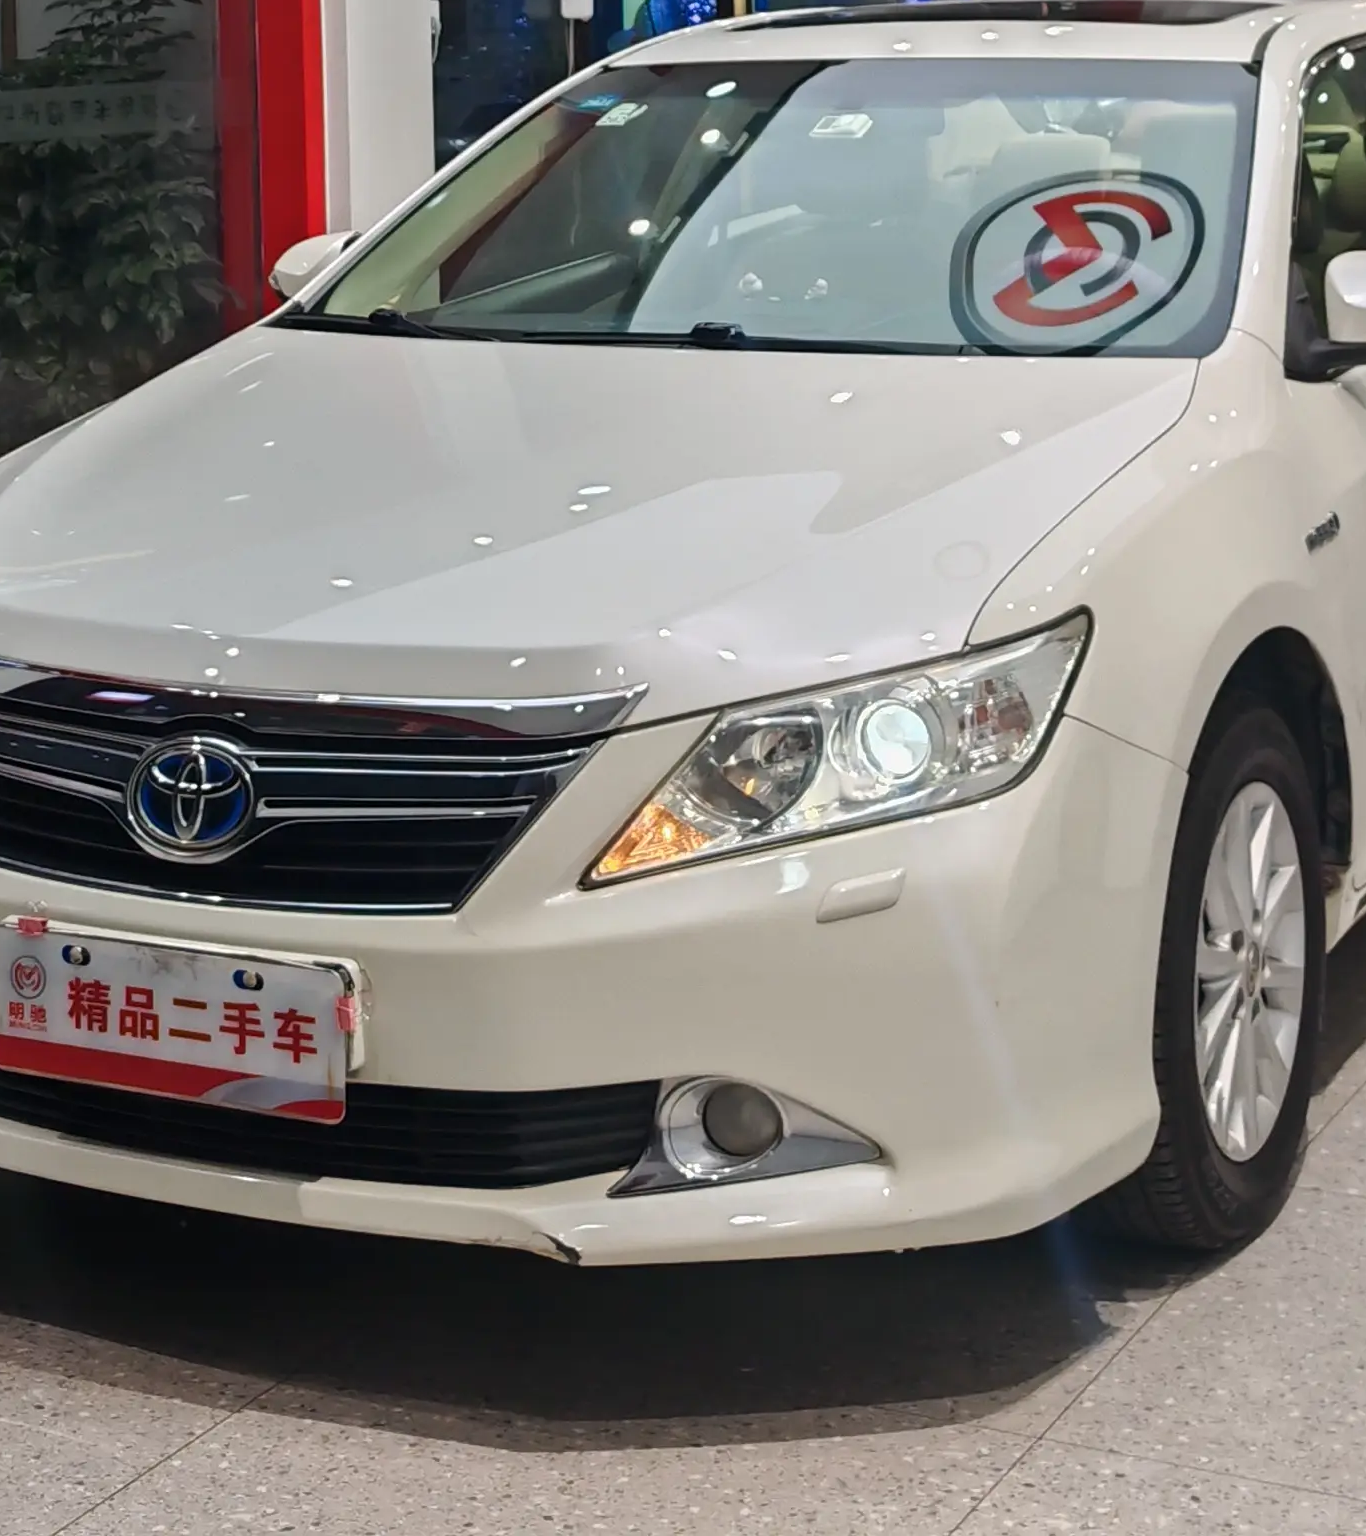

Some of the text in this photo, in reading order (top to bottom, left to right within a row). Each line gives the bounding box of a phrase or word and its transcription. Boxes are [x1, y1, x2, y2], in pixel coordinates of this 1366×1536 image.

[66, 977, 318, 1064] 精品二手车
